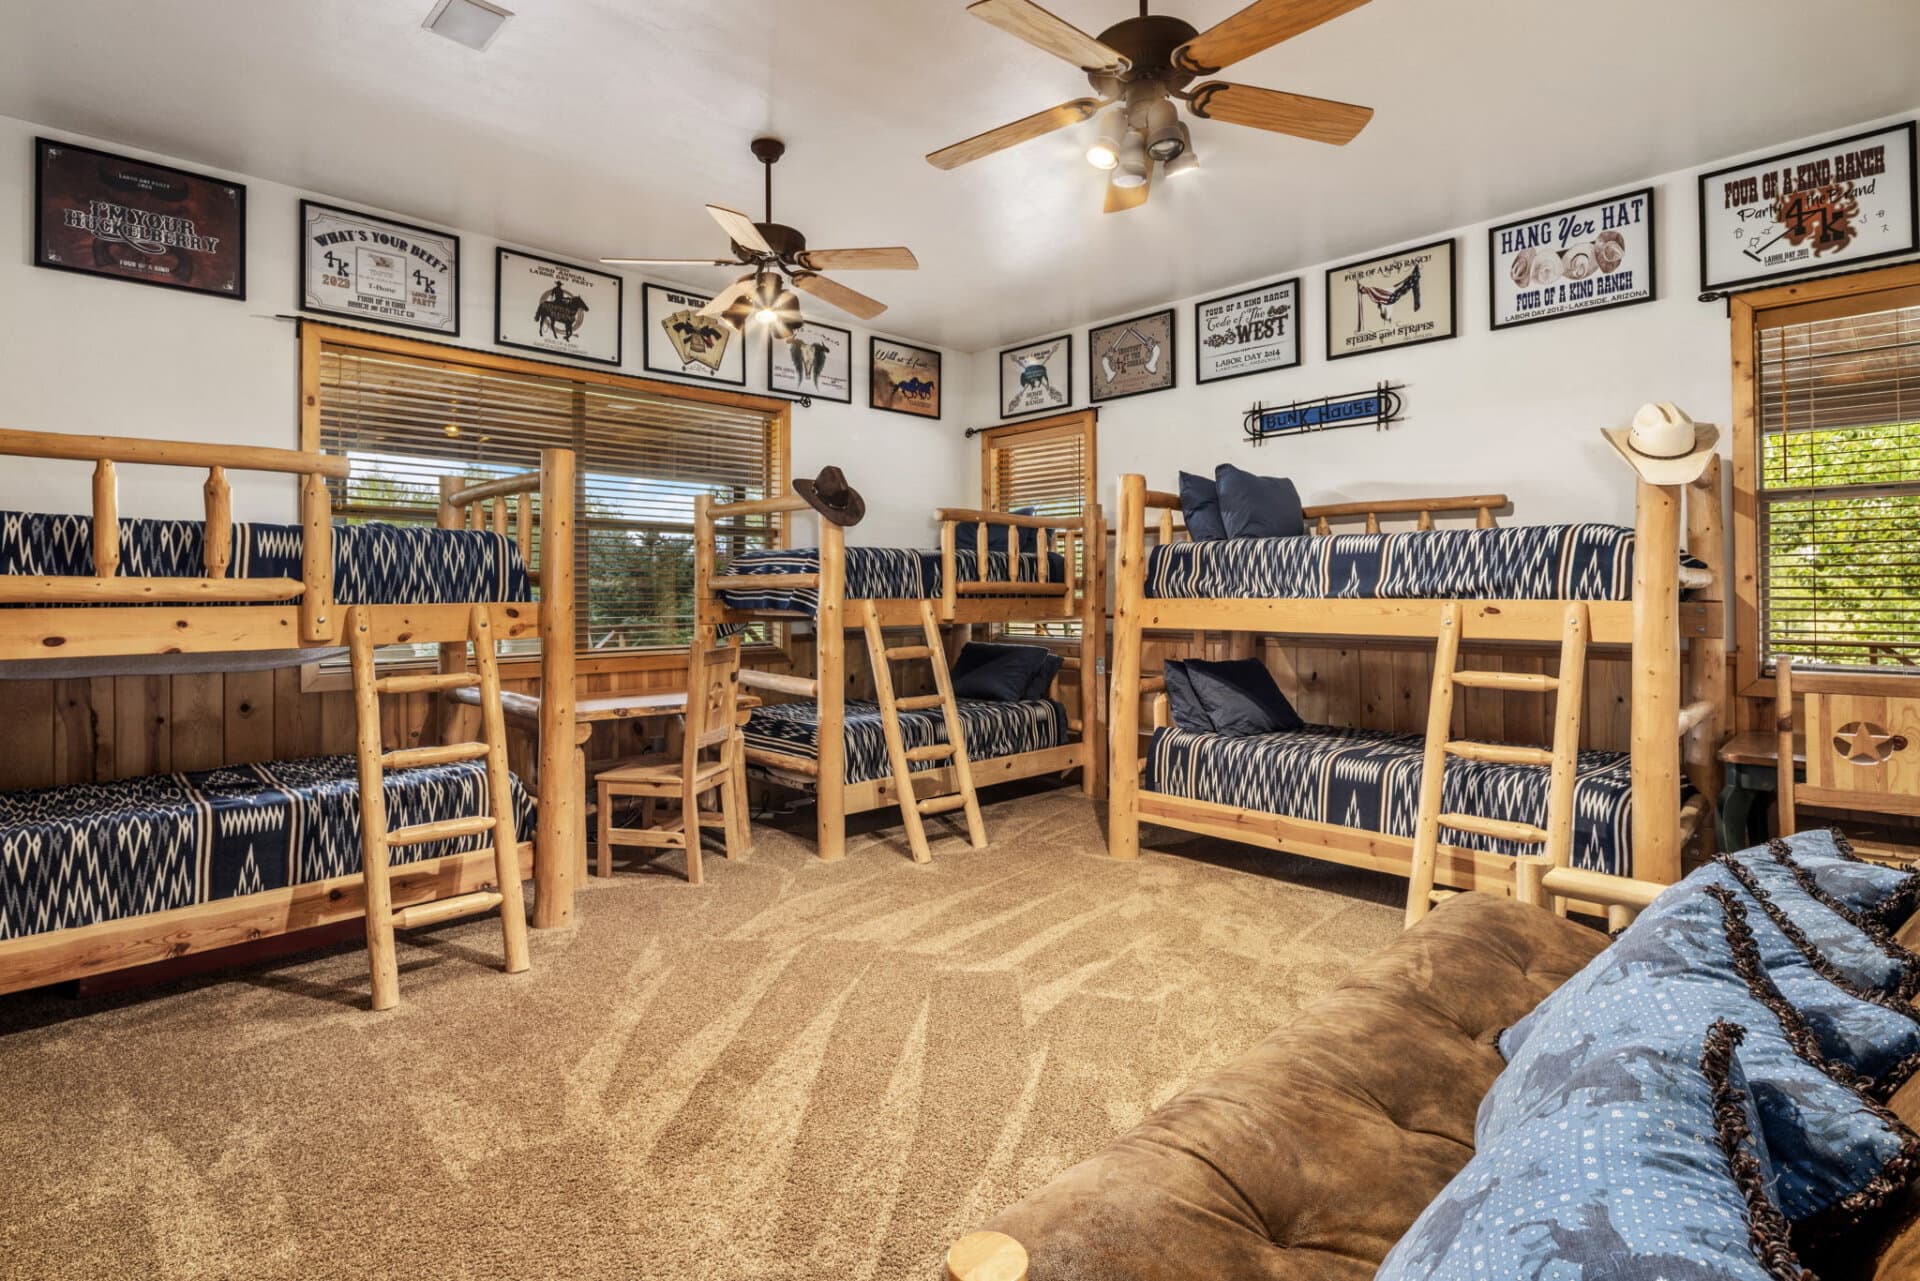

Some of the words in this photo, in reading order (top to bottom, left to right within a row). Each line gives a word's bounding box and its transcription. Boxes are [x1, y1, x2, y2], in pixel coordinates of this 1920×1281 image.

[1724, 176, 1758, 209] FOUR
[1762, 170, 1778, 200] OF
[1782, 167, 1793, 195] A
[1796, 158, 1831, 192] KIND
[1834, 144, 1886, 183] RANCH
[1737, 202, 1784, 224] Party
[1827, 178, 1876, 203] Brand
[131, 208, 195, 236] YOUR
[1501, 222, 1552, 255] HANG
[1558, 214, 1596, 249] Yer
[1602, 198, 1644, 231] HAT
[313, 230, 368, 247] WHAT'S
[371, 231, 408, 252] YOUR
[410, 245, 448, 274] BEEF?
[1344, 271, 1364, 282] FOUR
[1365, 268, 1375, 277] OF
[1516, 289, 1541, 312] FOUR
[1544, 284, 1556, 306] OF
[1559, 284, 1567, 303] A
[1569, 278, 1594, 301] KIND
[1597, 270, 1633, 296] RANCH
[1205, 306, 1223, 317] FOUR
[1226, 303, 1234, 312] OF
[1236, 302, 1242, 310] A
[1243, 296, 1261, 308] KIND
[1263, 290, 1289, 303] RANCH
[1505, 312, 1531, 322] LABOR
[1531, 309, 1546, 317] DAY
[1546, 305, 1565, 314] 2012
[1610, 289, 1648, 302] ARIZONA
[1235, 313, 1289, 345] WEST
[1244, 352, 1262, 361] DAY
